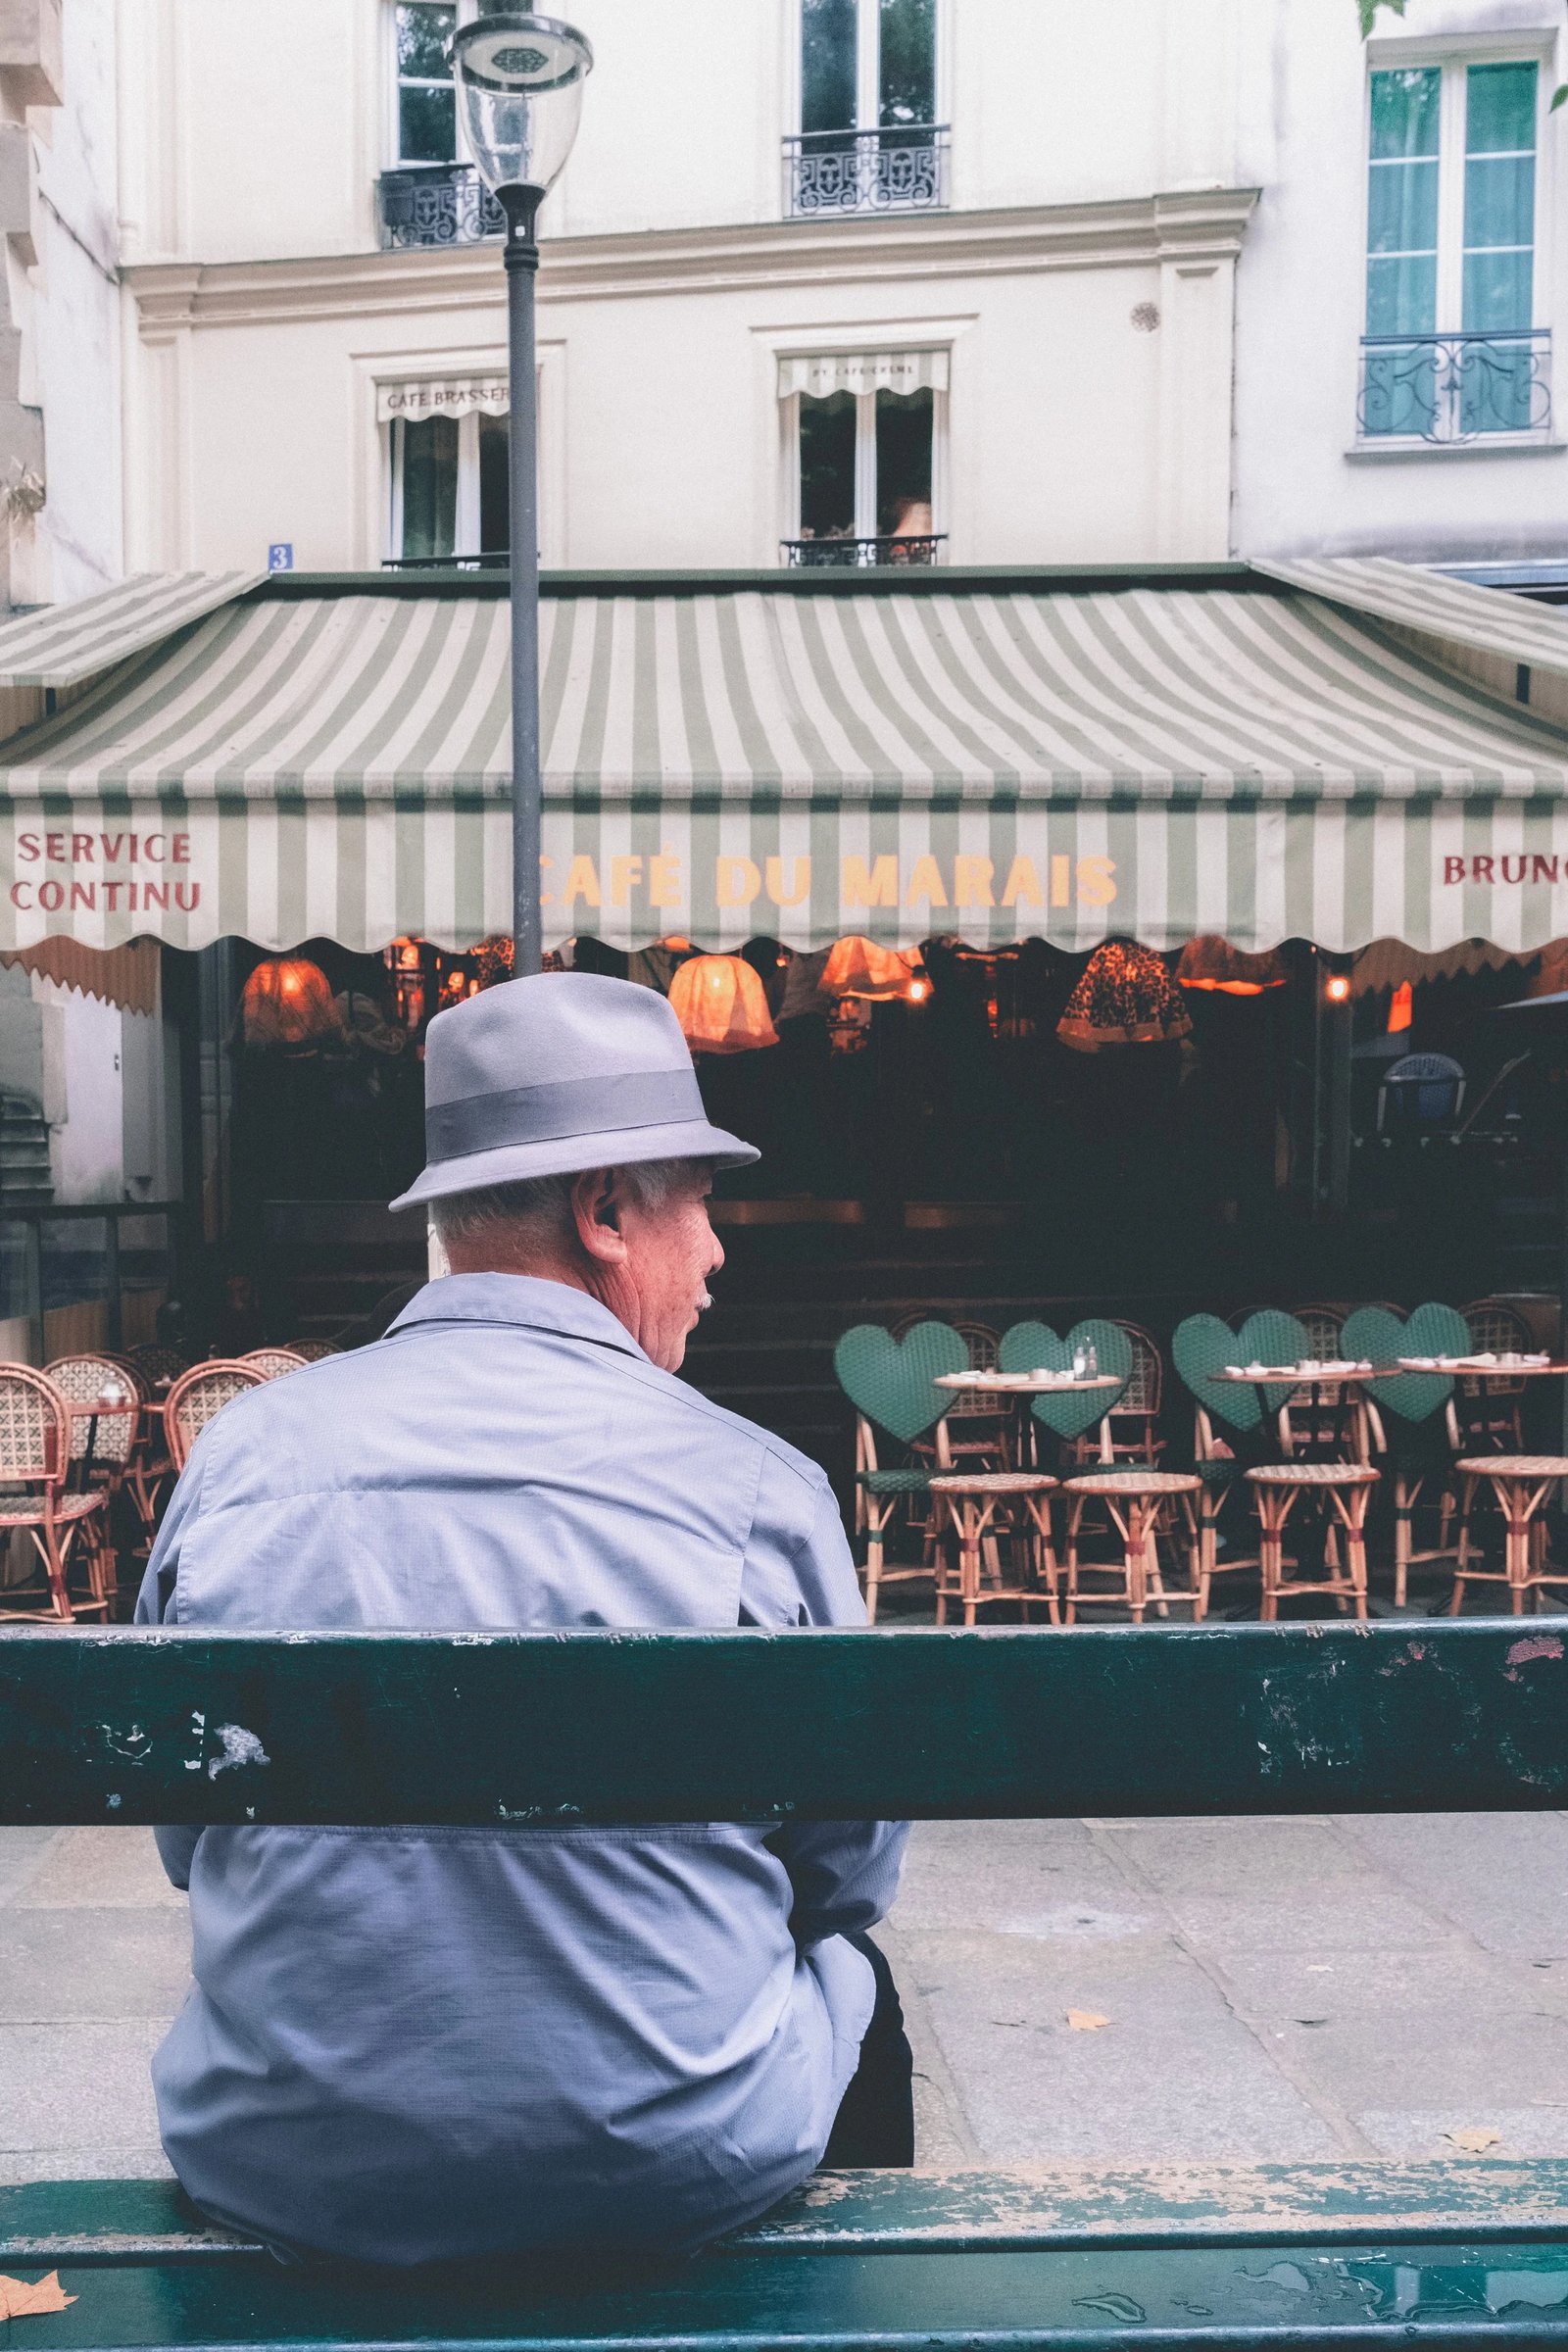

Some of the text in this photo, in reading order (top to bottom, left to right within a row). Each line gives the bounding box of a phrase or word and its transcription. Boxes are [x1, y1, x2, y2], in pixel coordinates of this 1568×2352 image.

[272, 546, 288, 568] 3
[17, 832, 191, 863] SERVICE
[715, 855, 812, 907] DU
[842, 854, 1118, 907] MARAIS
[1443, 854, 1568, 886] BRUN
[9, 880, 201, 912] CONTINU
